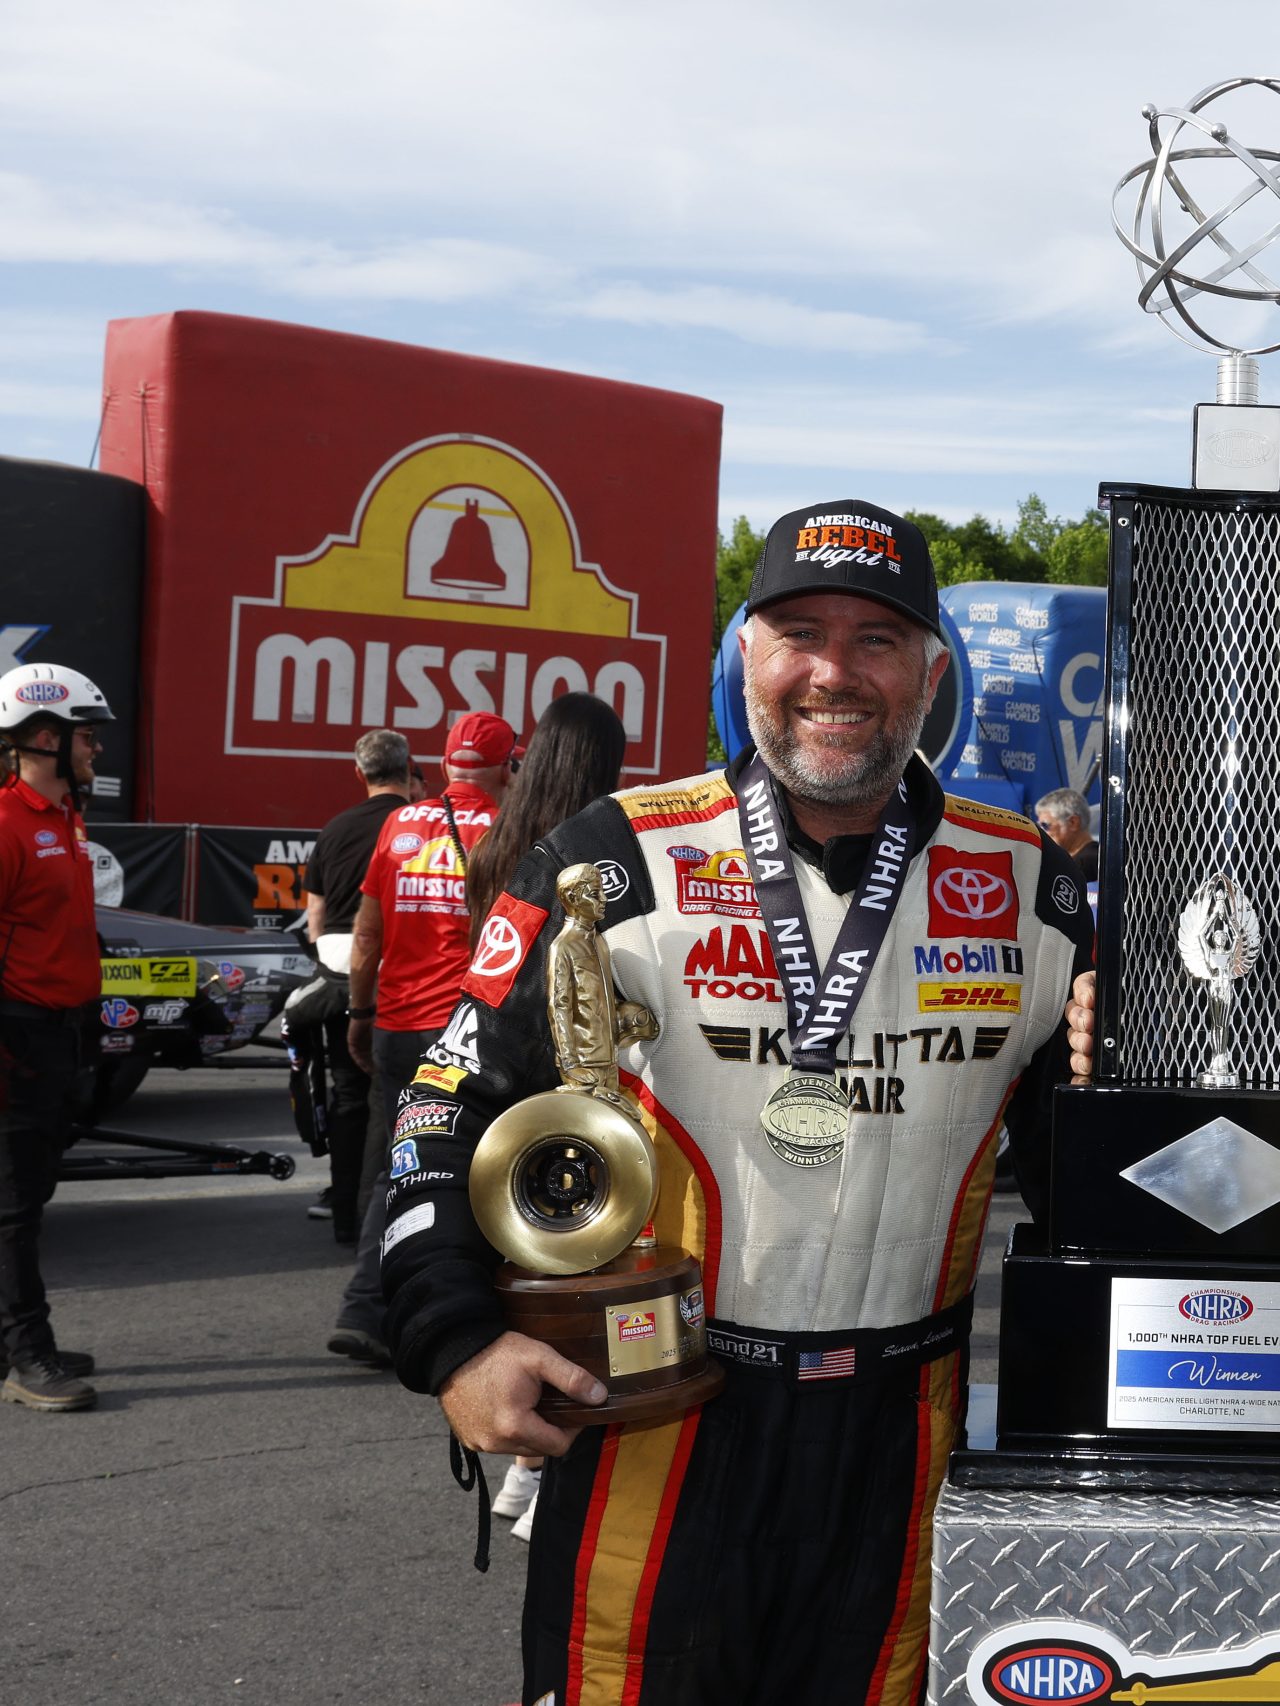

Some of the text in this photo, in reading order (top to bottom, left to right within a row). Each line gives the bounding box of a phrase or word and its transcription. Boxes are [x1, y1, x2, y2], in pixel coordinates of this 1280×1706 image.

[805, 515, 893, 537] AMERICAN
[796, 526, 902, 560] REBEL
[796, 551, 810, 560] EST
[810, 542, 883, 568] light
[968, 603, 999, 614] CAMPING
[1016, 607, 1049, 620] CAMPING
[968, 611, 998, 622] WORLD
[1016, 617, 1049, 629] WORLD
[1009, 653, 1045, 665] CAMPING
[1009, 662, 1045, 674] WORLD
[983, 673, 1015, 685] CAMPING
[22, 684, 62, 702] NHRA
[252, 633, 645, 743] MISSION
[983, 682, 1014, 695] WORLD
[1005, 701, 1040, 714] CAMPING
[1005, 711, 1040, 723] WORLD
[979, 731, 1009, 743] WORLD
[1001, 749, 1036, 762] CAMPING
[1001, 758, 1036, 772] WORLD
[398, 805, 493, 827] OFFICIA
[964, 805, 1004, 819] KALITTA
[744, 779, 786, 881] NHRA
[393, 836, 422, 852] NHRA
[671, 848, 706, 861] NHRA
[859, 824, 908, 911] NHRA
[397, 876, 465, 898] MISSIO
[601, 869, 620, 890] 21
[688, 880, 757, 902] MISSI
[1056, 884, 1075, 906] 21
[395, 903, 417, 913] DRAG
[419, 903, 452, 914] RACING
[682, 903, 753, 917] DRAG RACING
[257, 918, 276, 927] EST
[914, 944, 997, 975] Mobil
[102, 964, 142, 980] IXXON
[683, 979, 786, 1002] TOOL
[940, 987, 1009, 1006] DHL
[801, 949, 870, 1050] NHRA
[102, 999, 128, 1028] VP
[757, 1026, 965, 1069] KLITTA
[794, 1078, 831, 1089] EVENT
[840, 1077, 905, 1114] AIR
[777, 1097, 840, 1111] CHAMPIONSHIP
[778, 1107, 841, 1136] NHRA
[776, 1130, 836, 1146] DRAG RACING
[785, 1151, 827, 1165] WINNER
[401, 1171, 454, 1189] THIRD
[1190, 1288, 1241, 1298] CHAMPIONSHIP
[1190, 1295, 1243, 1319] NHRA
[1190, 1316, 1210, 1326] DRAG
[622, 1325, 653, 1336] MISSION
[1127, 1332, 1168, 1344] 1,000TH
[1171, 1335, 1203, 1344] NHRA
[1207, 1335, 1228, 1345] TOP
[1232, 1336, 1261, 1346] FUEL
[709, 1334, 777, 1361] tand21
[1168, 1355, 1262, 1387] Winner
[1137, 1396, 1174, 1404] AMERICAN
[1241, 1399, 1266, 1407] 4-WIDE
[1179, 1406, 1245, 1417] CHARLOTTE, NC
[1010, 1659, 1096, 1698] NHRA
